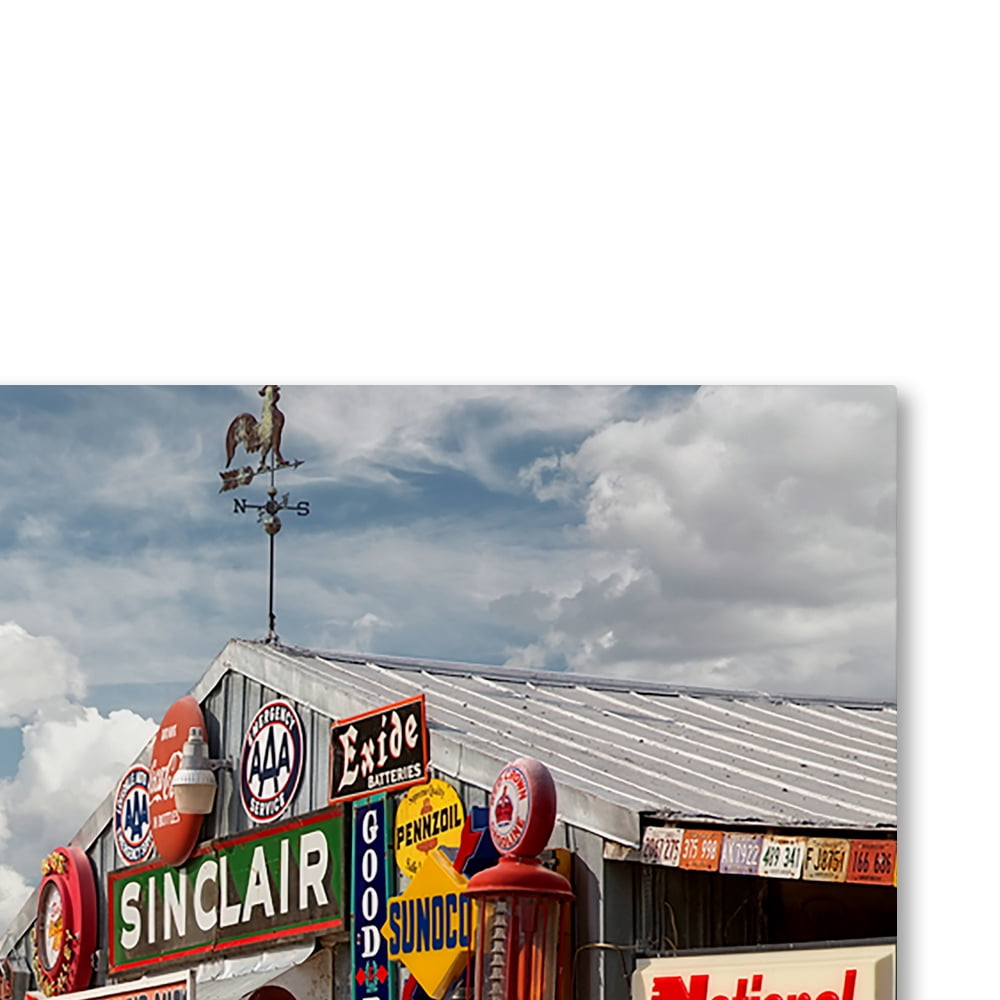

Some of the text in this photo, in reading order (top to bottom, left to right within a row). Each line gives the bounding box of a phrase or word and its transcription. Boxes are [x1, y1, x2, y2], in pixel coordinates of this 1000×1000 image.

[233, 498, 247, 514] N
[296, 501, 310, 517] S
[250, 725, 291, 798] AAA
[338, 710, 419, 792] Exide
[367, 762, 422, 789] BATTERIES
[249, 796, 285, 816] SERVICE
[396, 803, 462, 851] PENNZOIL
[120, 830, 329, 950] SINCLAIR
[388, 892, 471, 954] SUNOCO
